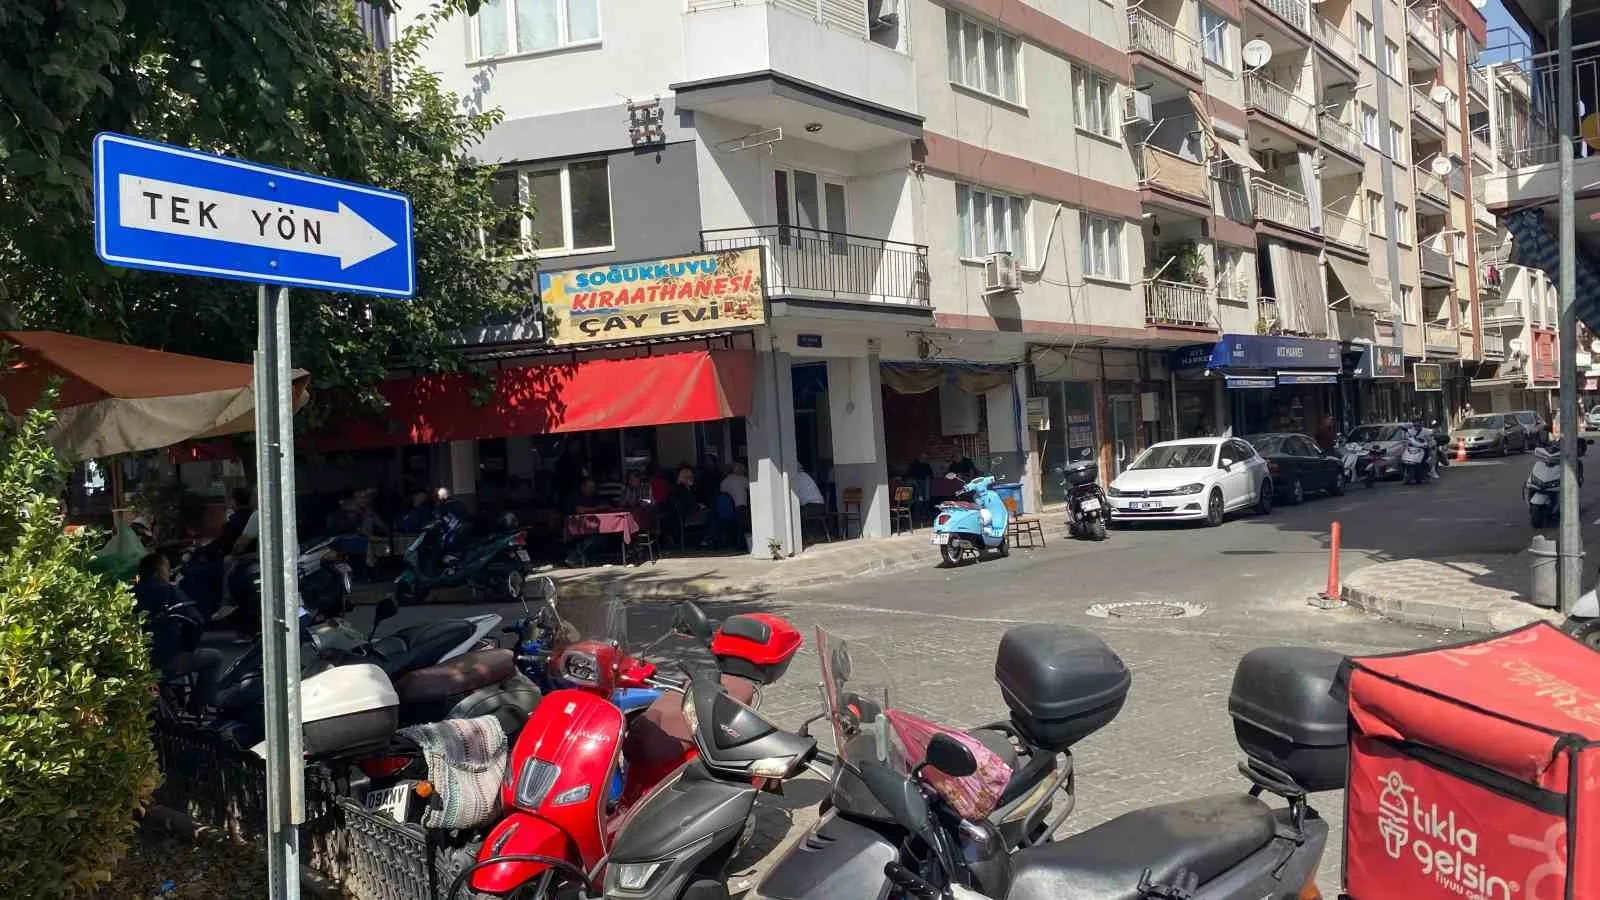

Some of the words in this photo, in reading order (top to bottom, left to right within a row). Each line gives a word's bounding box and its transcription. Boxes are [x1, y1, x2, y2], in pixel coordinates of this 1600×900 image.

[143, 191, 218, 230] TEK
[251, 207, 321, 245] YÖN
[572, 270, 752, 310] KIRAATHANESİ
[575, 258, 718, 289] SOĞUKKUYU
[579, 314, 649, 337] ÇAY
[660, 301, 719, 325] EVİ
[1413, 796, 1477, 856] tıkla
